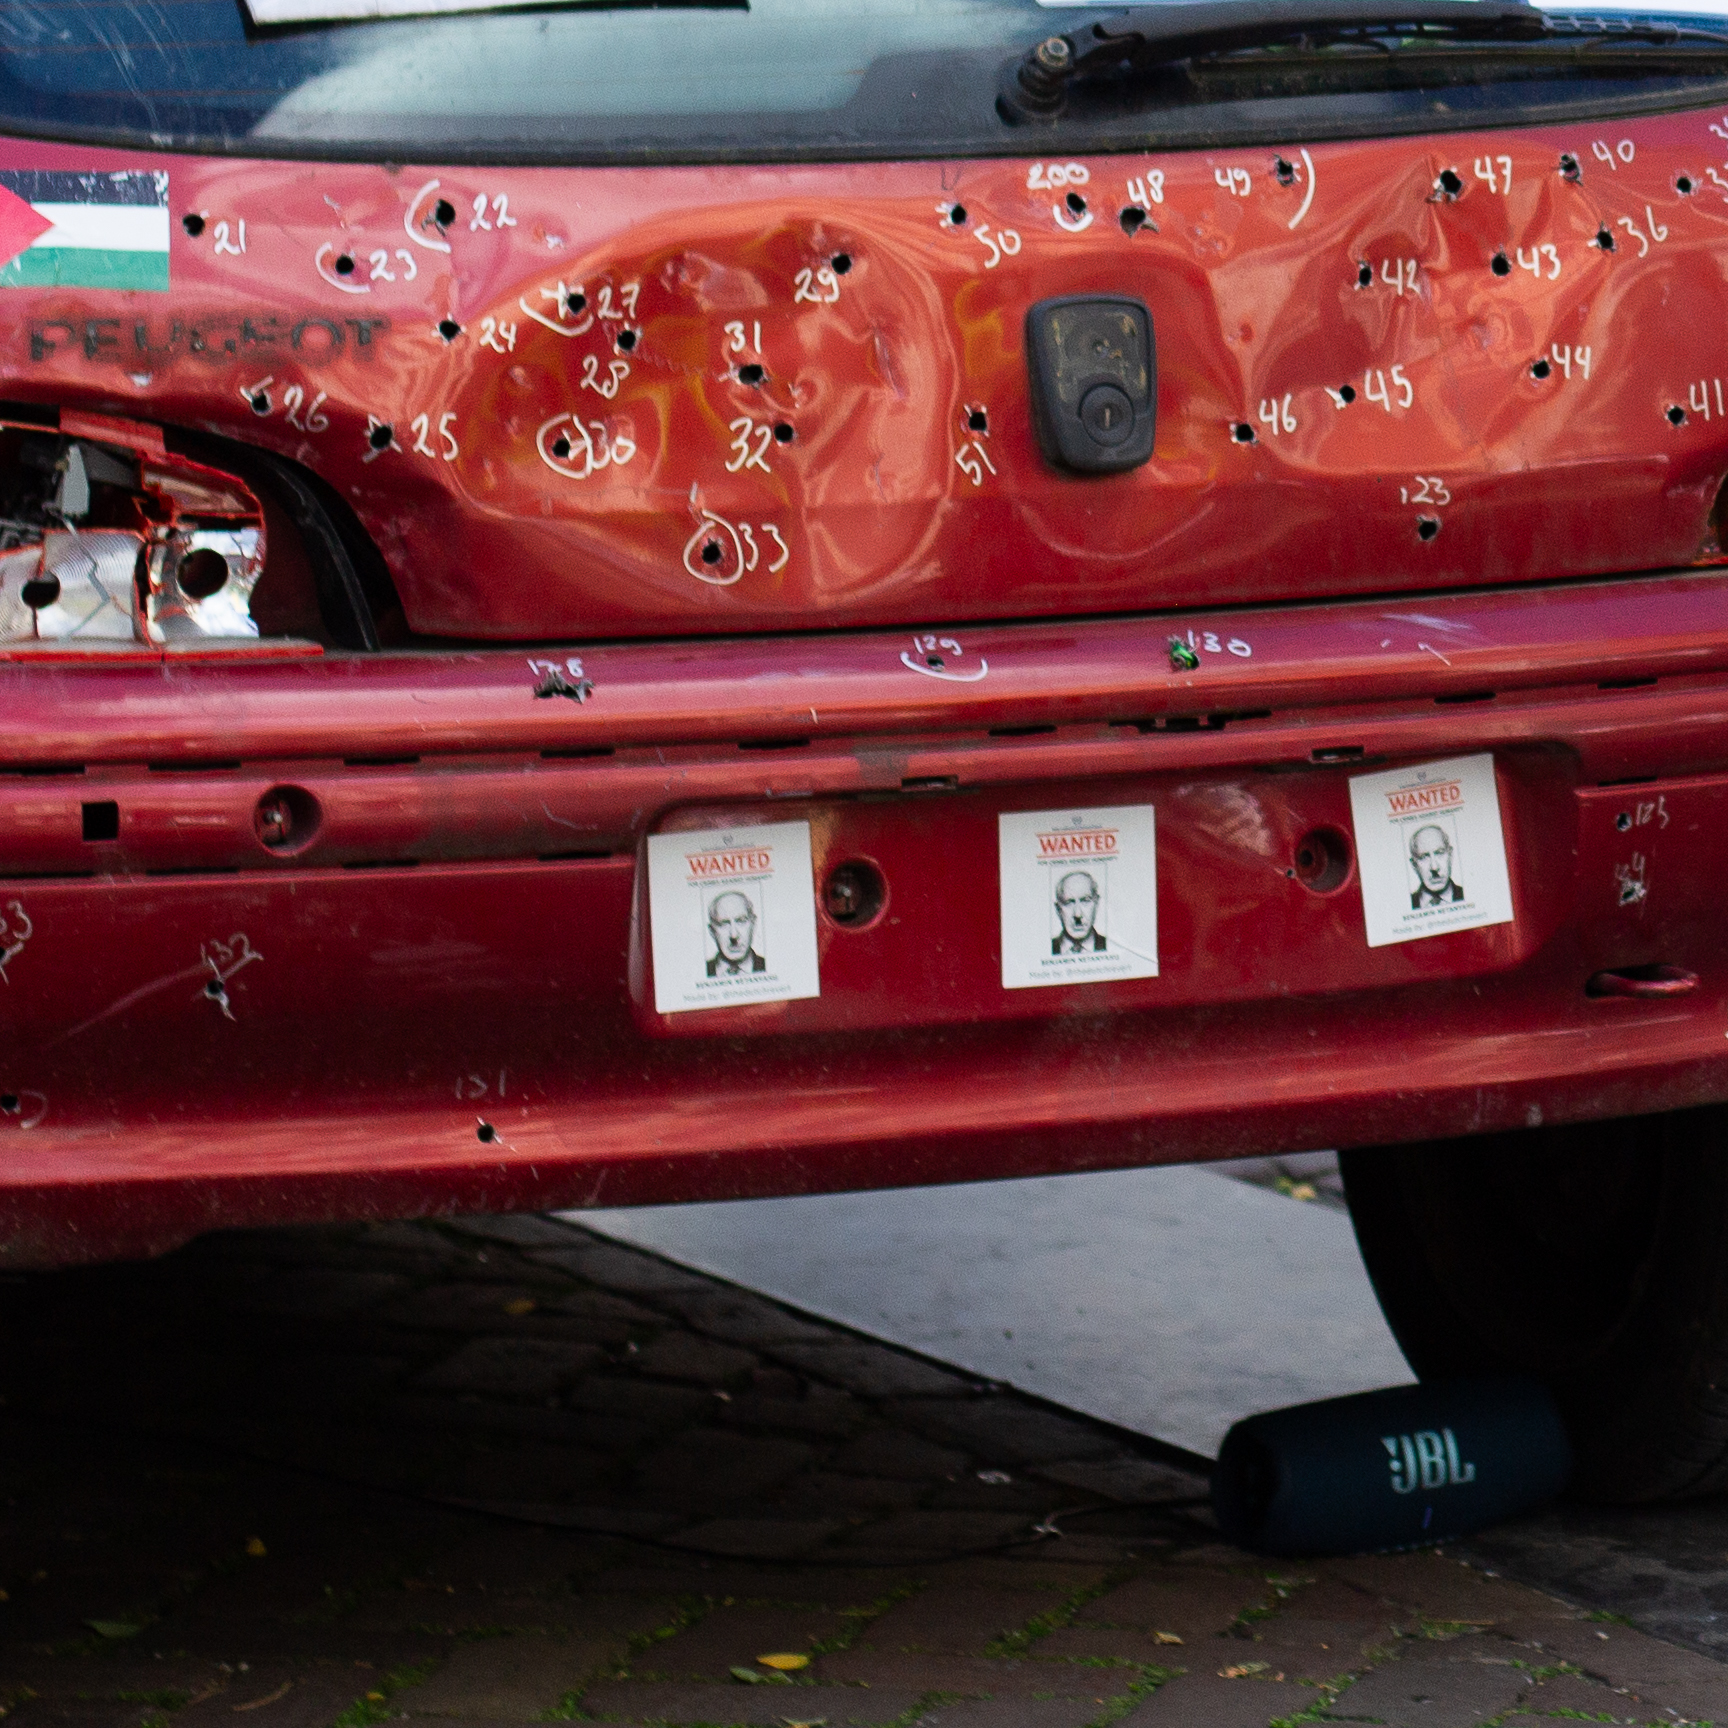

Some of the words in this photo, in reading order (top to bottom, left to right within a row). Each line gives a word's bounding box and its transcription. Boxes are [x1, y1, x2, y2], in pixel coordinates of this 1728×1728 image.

[1593, 140, 1635, 170] 40
[1128, 170, 1165, 209] 48
[1215, 167, 1252, 197] 49
[1474, 156, 1512, 195] 47
[469, 194, 518, 230] 22
[214, 219, 247, 255] 21
[973, 224, 1022, 270] 50
[1618, 212, 1670, 259] 36
[370, 249, 418, 282] 23
[1381, 257, 1422, 296] 42
[1517, 243, 1563, 279] 43
[596, 284, 640, 321] 27
[794, 266, 841, 303] 29
[28, 314, 386, 364] PEUGEOT
[478, 317, 518, 353] 24
[724, 320, 763, 353] 31
[1552, 344, 1592, 381] 44
[283, 386, 330, 432] 26
[1363, 369, 1415, 411] 45
[1690, 379, 1725, 420] 41
[1258, 393, 1299, 434] 46
[411, 412, 459, 461] 25
[725, 417, 773, 473] 32
[955, 441, 997, 486] 51
[1400, 475, 1451, 507] 123
[737, 523, 789, 573] 33
[1389, 784, 1461, 812] WANTED
[1038, 834, 1116, 854] WANTED
[688, 852, 770, 876] WANTED
[1381, 1427, 1477, 1494] JBL
